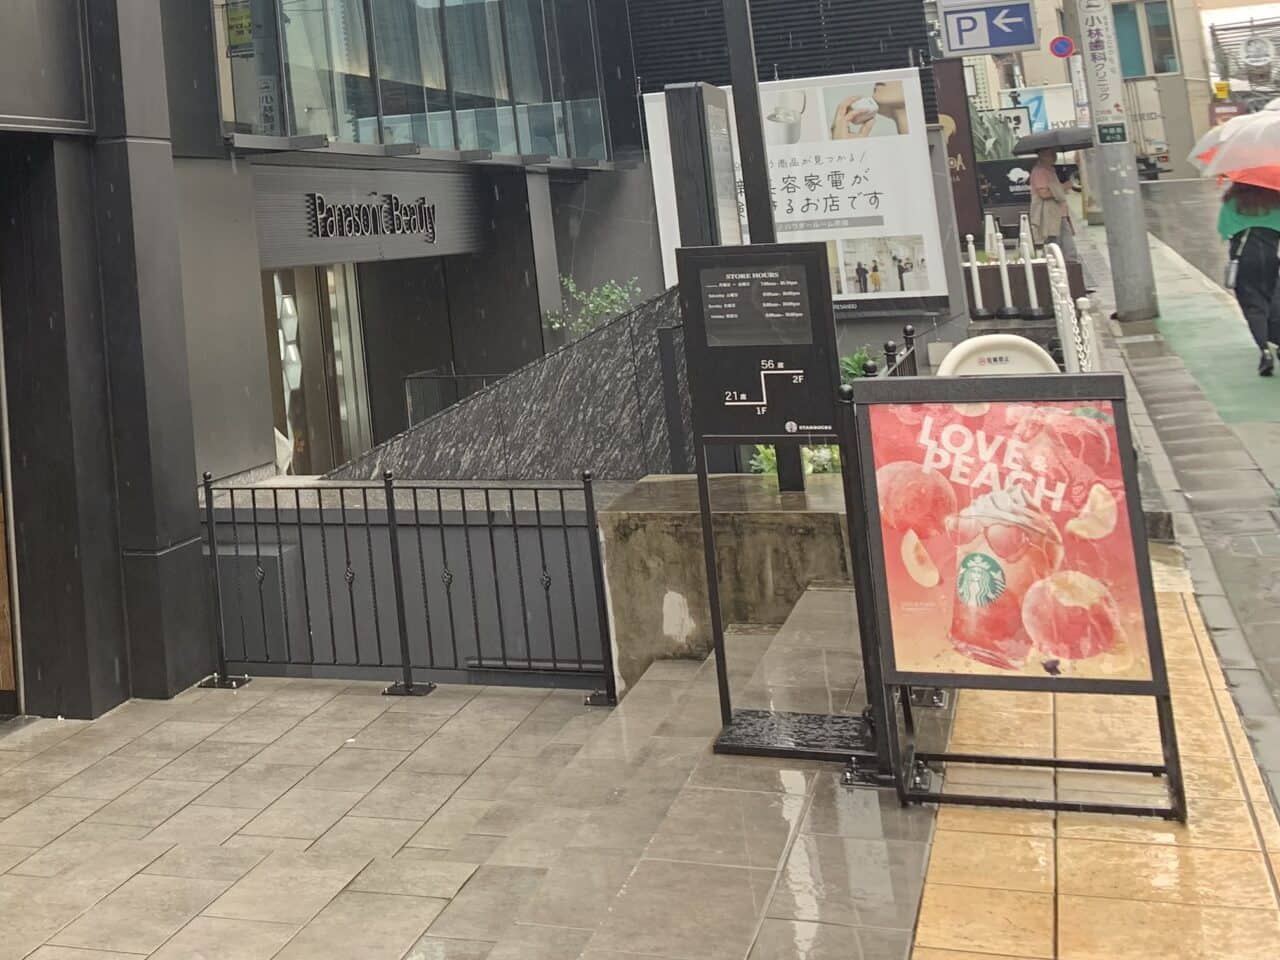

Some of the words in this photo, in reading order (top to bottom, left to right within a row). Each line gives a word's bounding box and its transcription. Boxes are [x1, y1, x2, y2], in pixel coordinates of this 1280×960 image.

[956, 15, 978, 46] P
[770, 168, 871, 195] 容家電が
[307, 191, 391, 238] Panasonic
[391, 193, 437, 245] Beauty
[792, 375, 804, 384] 2F
[756, 407, 767, 415] 1F
[916, 415, 1028, 471] LOVE
[922, 443, 1068, 513] PEACH
